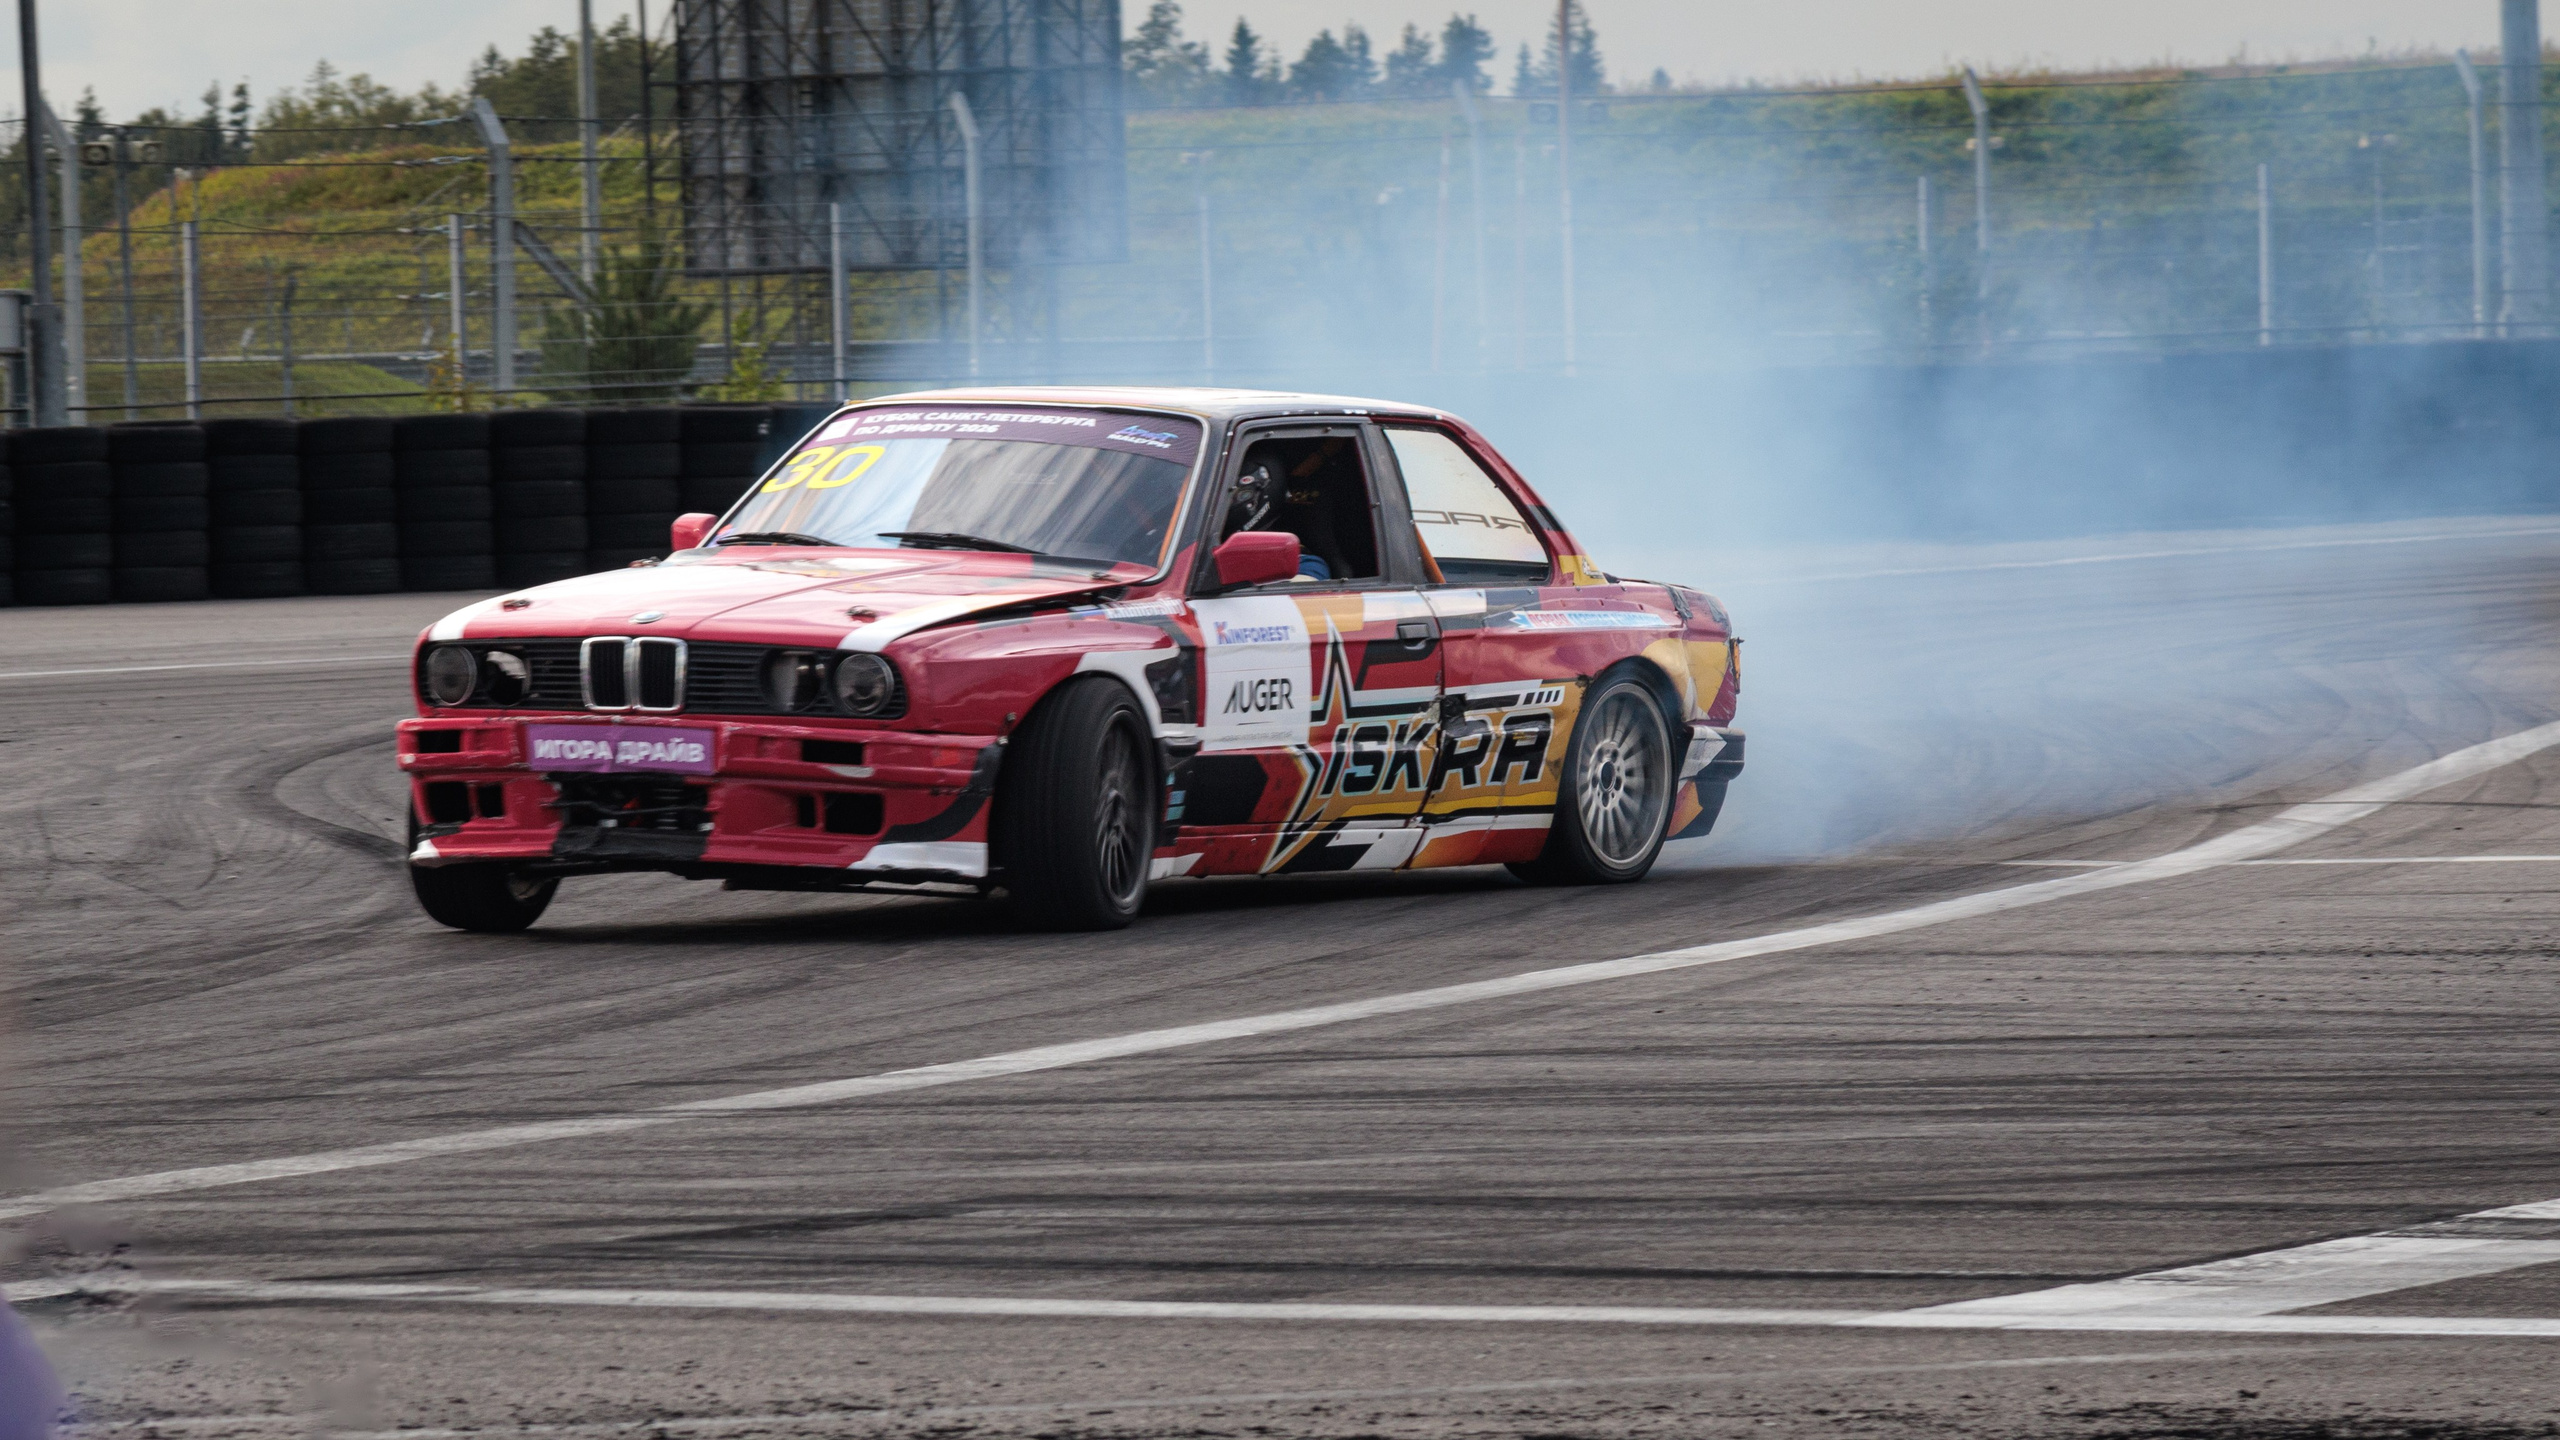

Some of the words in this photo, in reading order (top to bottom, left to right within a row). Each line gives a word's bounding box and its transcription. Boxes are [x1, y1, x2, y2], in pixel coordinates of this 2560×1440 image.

[852, 425, 880, 436] ПО
[879, 423, 957, 436] ДРИФТУ
[863, 411, 923, 425] КУБОК
[923, 411, 1097, 428] САНКТ-ПЕТЕРБУРГА
[760, 445, 885, 493] 30
[1214, 621, 1290, 645] KINFOREST
[1223, 678, 1295, 714] AUGER
[533, 739, 614, 760] ИГОРА
[615, 737, 706, 764] ДРАЙВ
[1319, 709, 1554, 796] ISKRA
